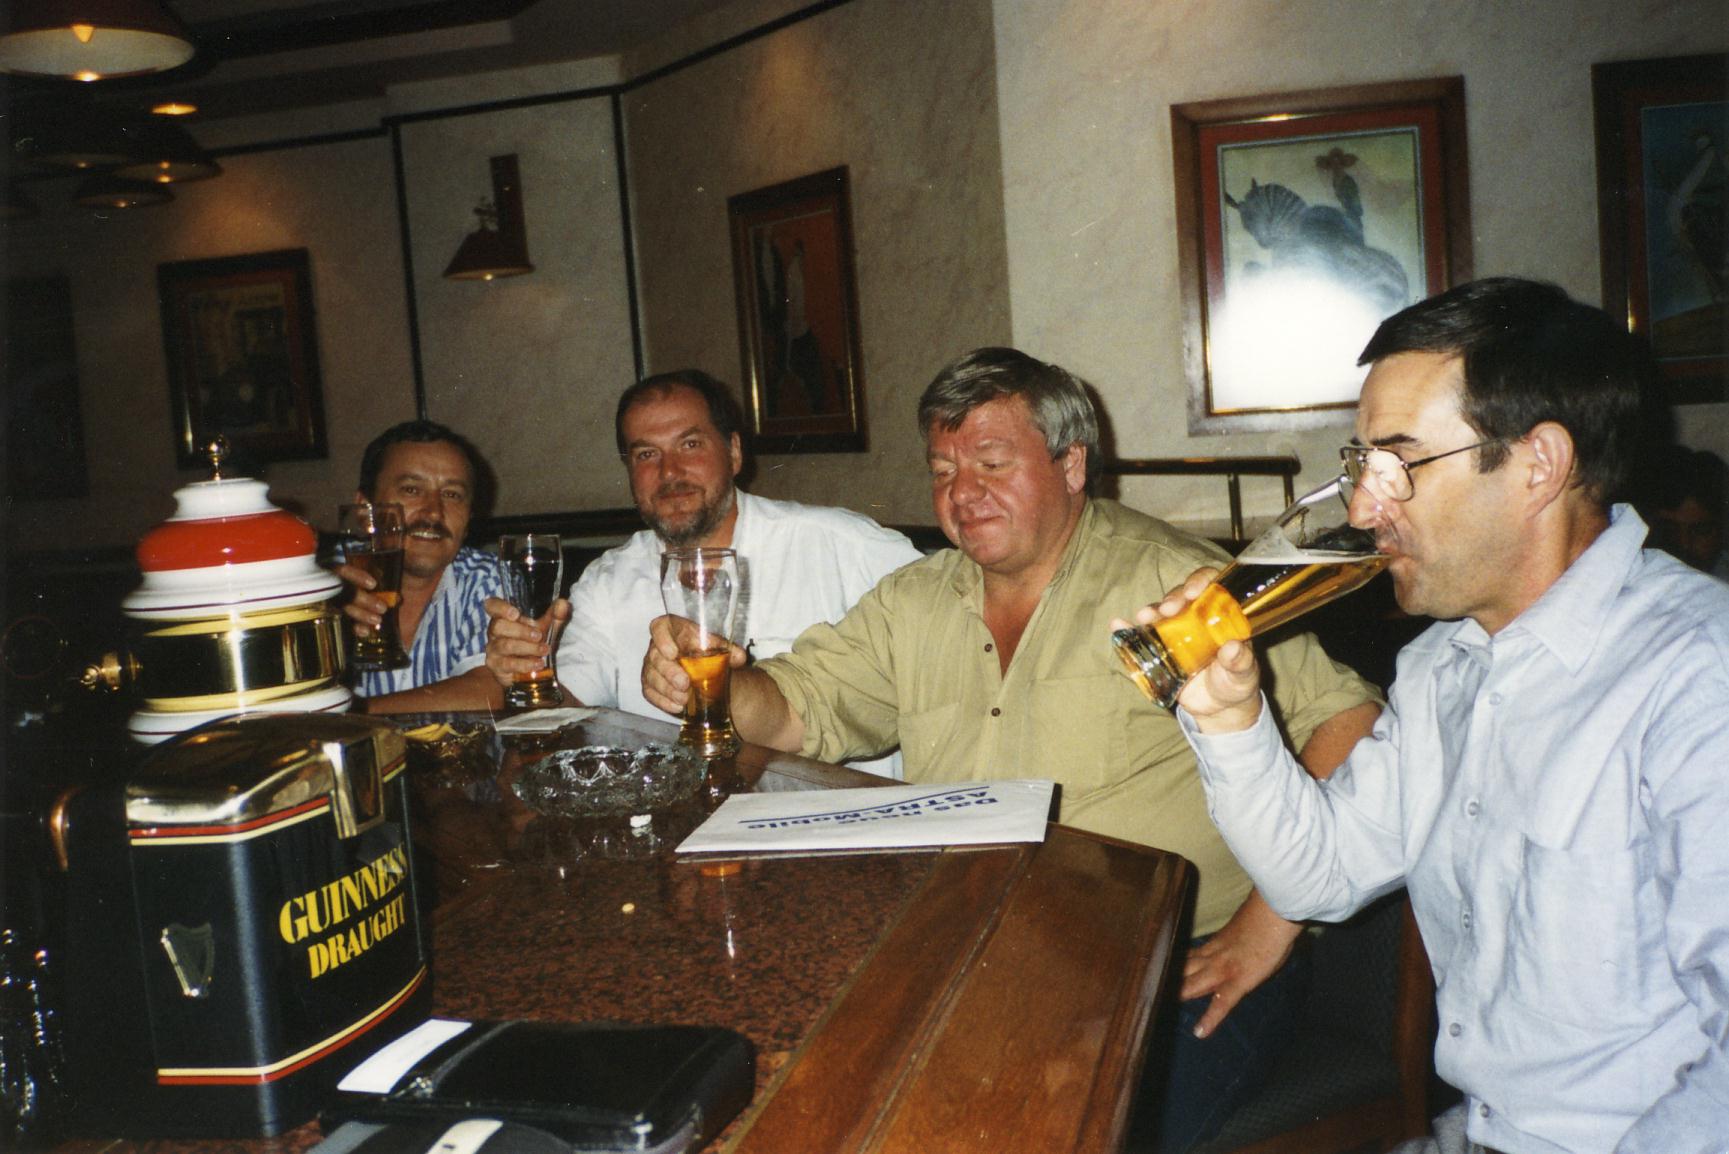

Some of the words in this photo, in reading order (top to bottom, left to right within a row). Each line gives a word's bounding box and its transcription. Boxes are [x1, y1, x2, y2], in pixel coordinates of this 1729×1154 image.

[747, 790, 988, 830] ASTRA-Mobile
[838, 810, 922, 825] neue
[933, 797, 998, 812] Das
[279, 841, 408, 945] GUINNESS
[307, 892, 405, 979] DRAUGHT
